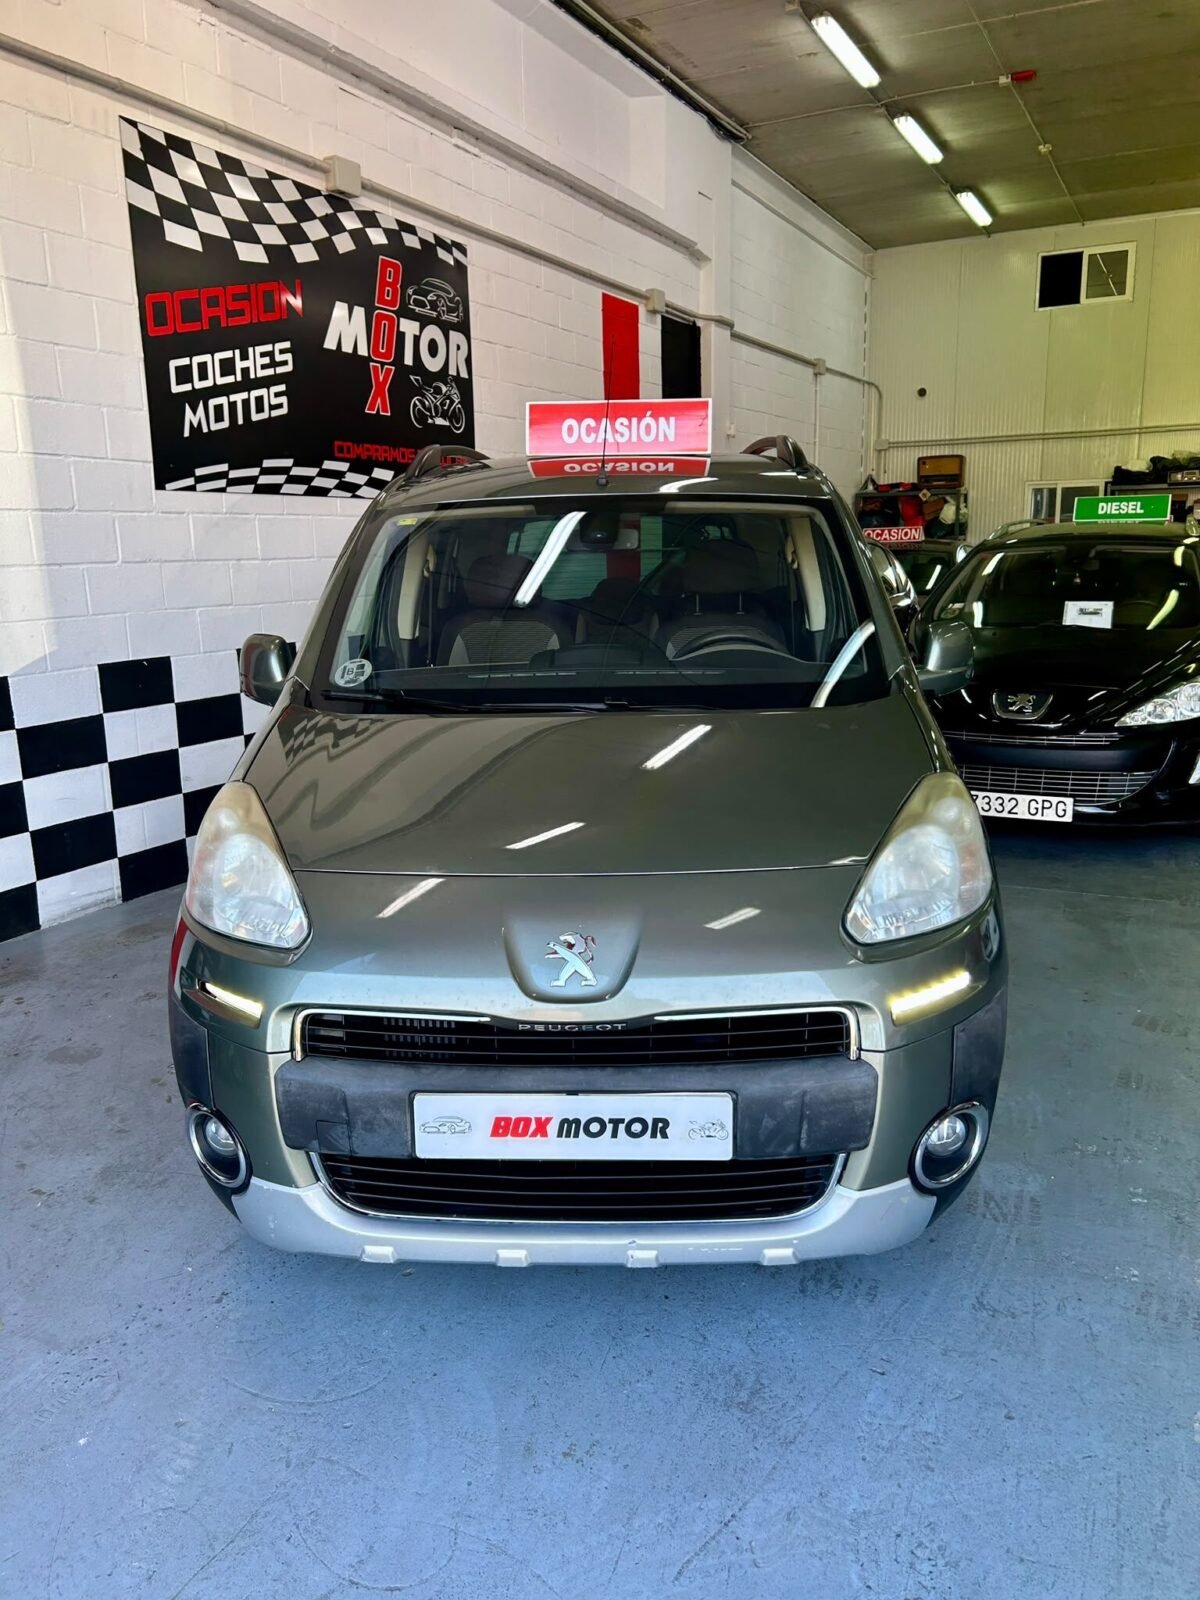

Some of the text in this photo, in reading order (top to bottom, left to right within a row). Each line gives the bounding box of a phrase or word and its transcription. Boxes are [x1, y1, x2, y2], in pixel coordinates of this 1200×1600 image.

[145, 279, 303, 337] OCASION
[365, 255, 402, 416] BOX
[169, 341, 293, 394] COCHES
[183, 384, 289, 438] MOTOS
[561, 410, 676, 444] OCASIÓN
[334, 441, 416, 464] COMPRAMOS
[1098, 502, 1144, 514] DIESEL
[864, 529, 920, 541] OCASION
[1028, 799, 1067, 818] GPG
[518, 1023, 627, 1032] PEUGEOT
[490, 1116, 670, 1139] BOX MOTOR
